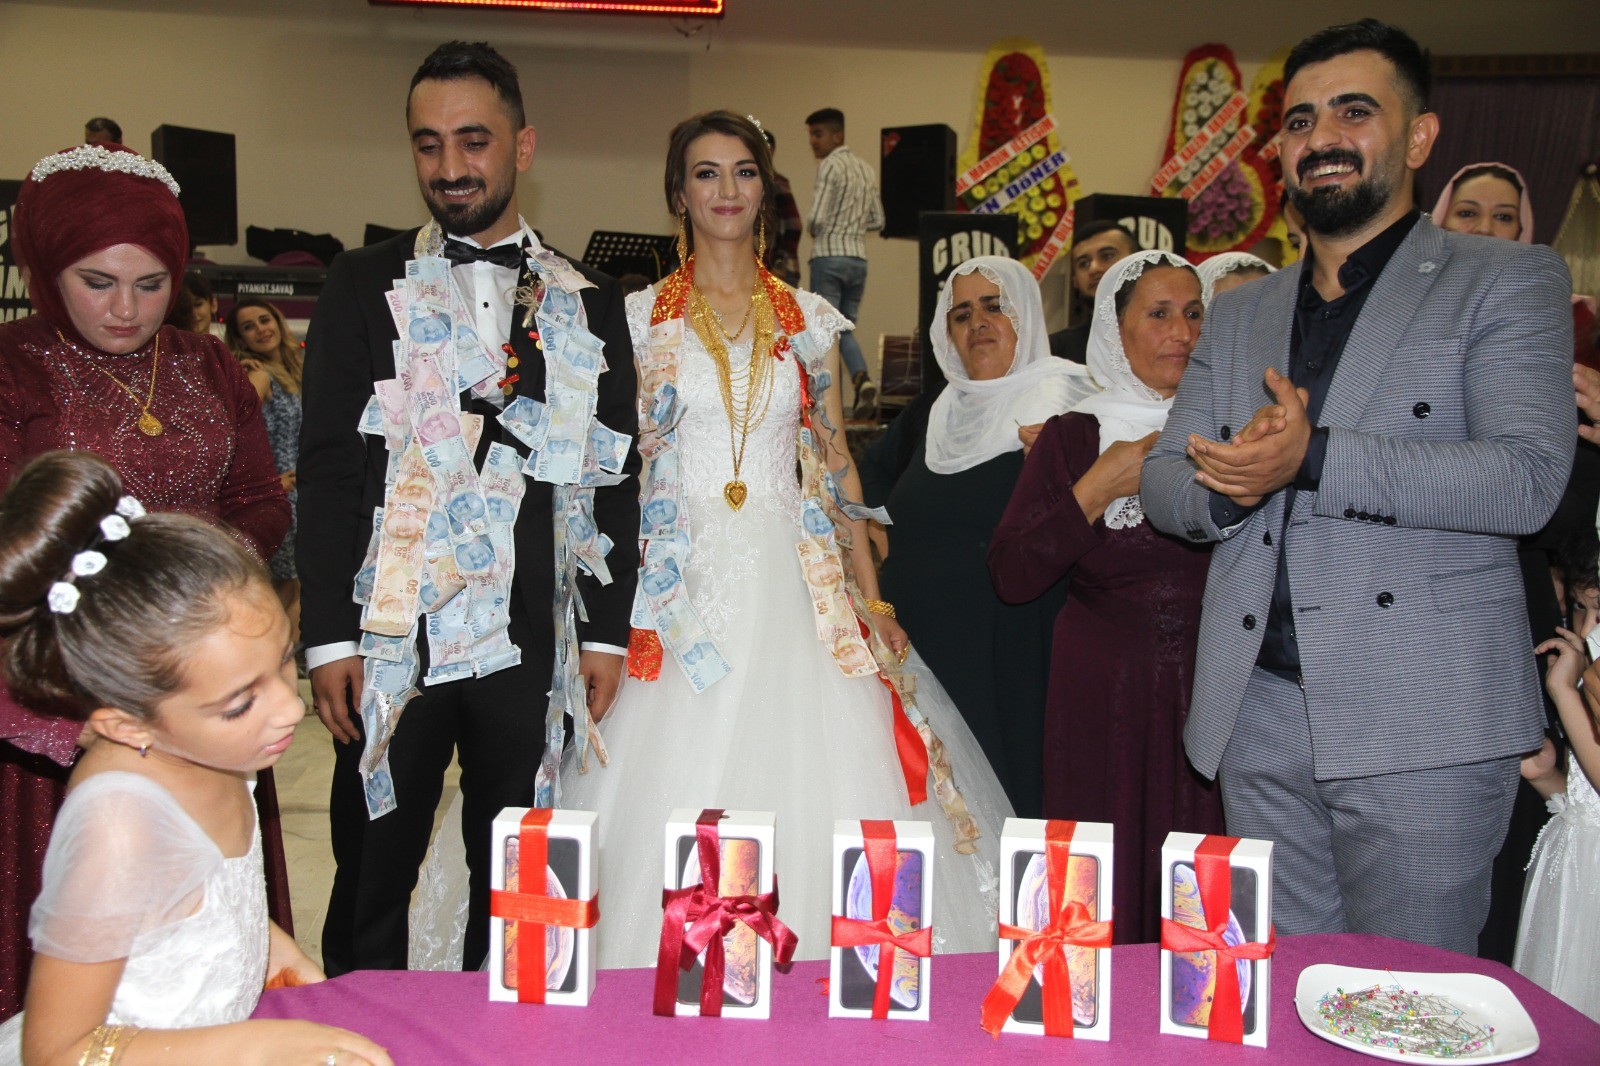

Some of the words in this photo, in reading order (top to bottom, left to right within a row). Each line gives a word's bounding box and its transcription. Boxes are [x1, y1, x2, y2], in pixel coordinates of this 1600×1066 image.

[389, 293, 403, 313] 200
[401, 370, 412, 391] 200
[424, 448, 441, 468] 100
[488, 446, 503, 466] 100
[537, 460, 549, 479] 100
[572, 468, 580, 480] 100
[406, 579, 418, 595] 50
[634, 608, 644, 626] 100
[816, 601, 828, 615] 50
[429, 613, 440, 636] 100
[655, 615, 668, 632] 100
[689, 671, 706, 690] 100
